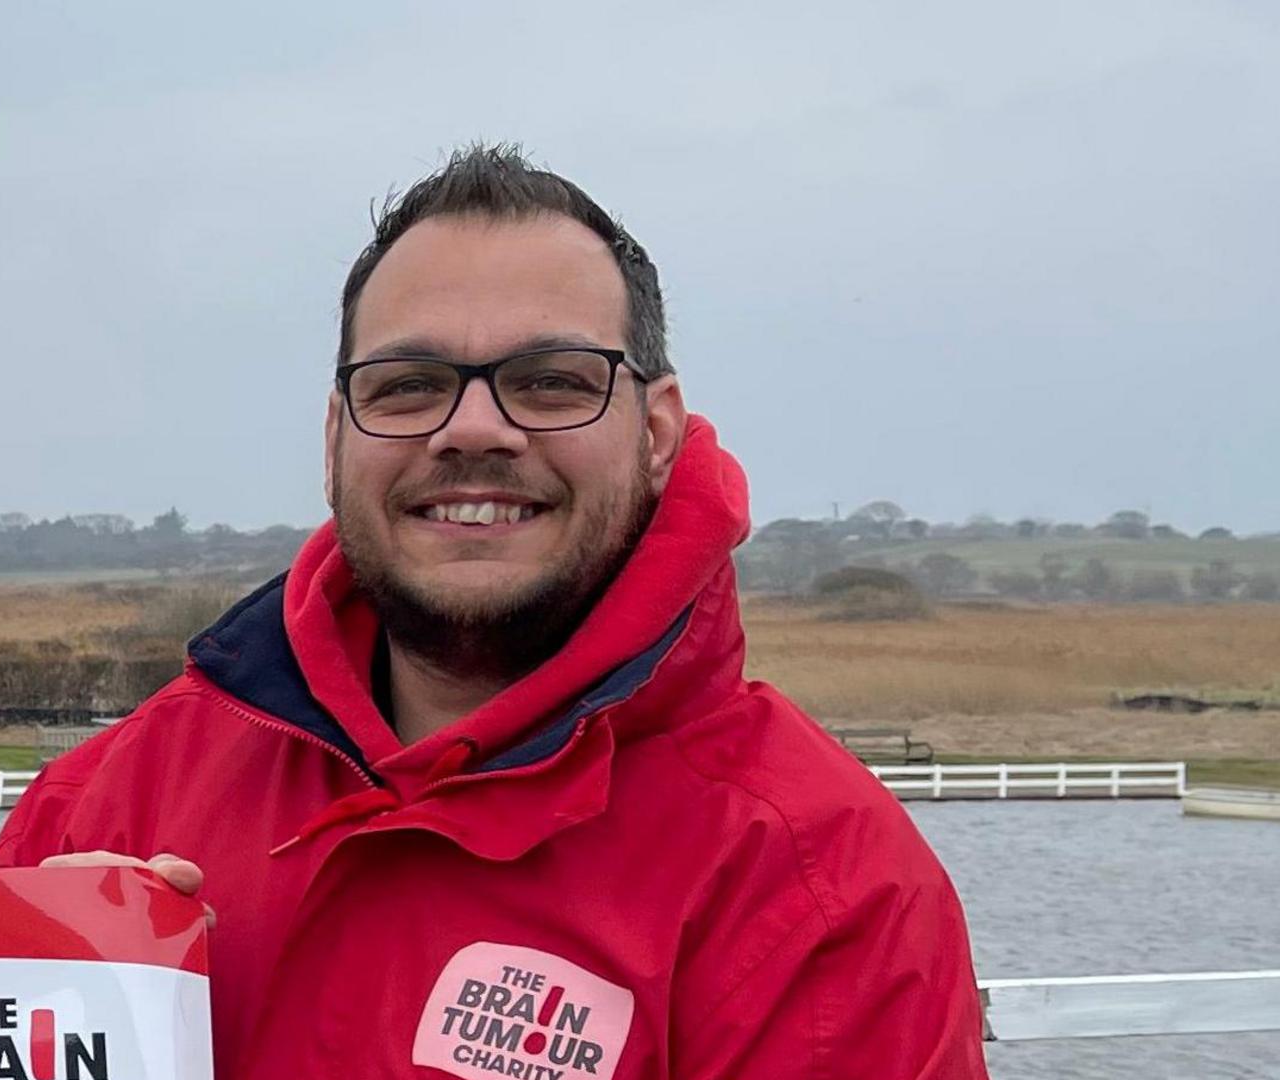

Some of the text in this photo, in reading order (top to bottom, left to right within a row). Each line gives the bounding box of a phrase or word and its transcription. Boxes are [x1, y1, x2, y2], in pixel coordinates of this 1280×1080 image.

[456, 978, 591, 1036] BRAIN
[501, 965, 547, 993] THE
[439, 1006, 604, 1075] TUMOUR
